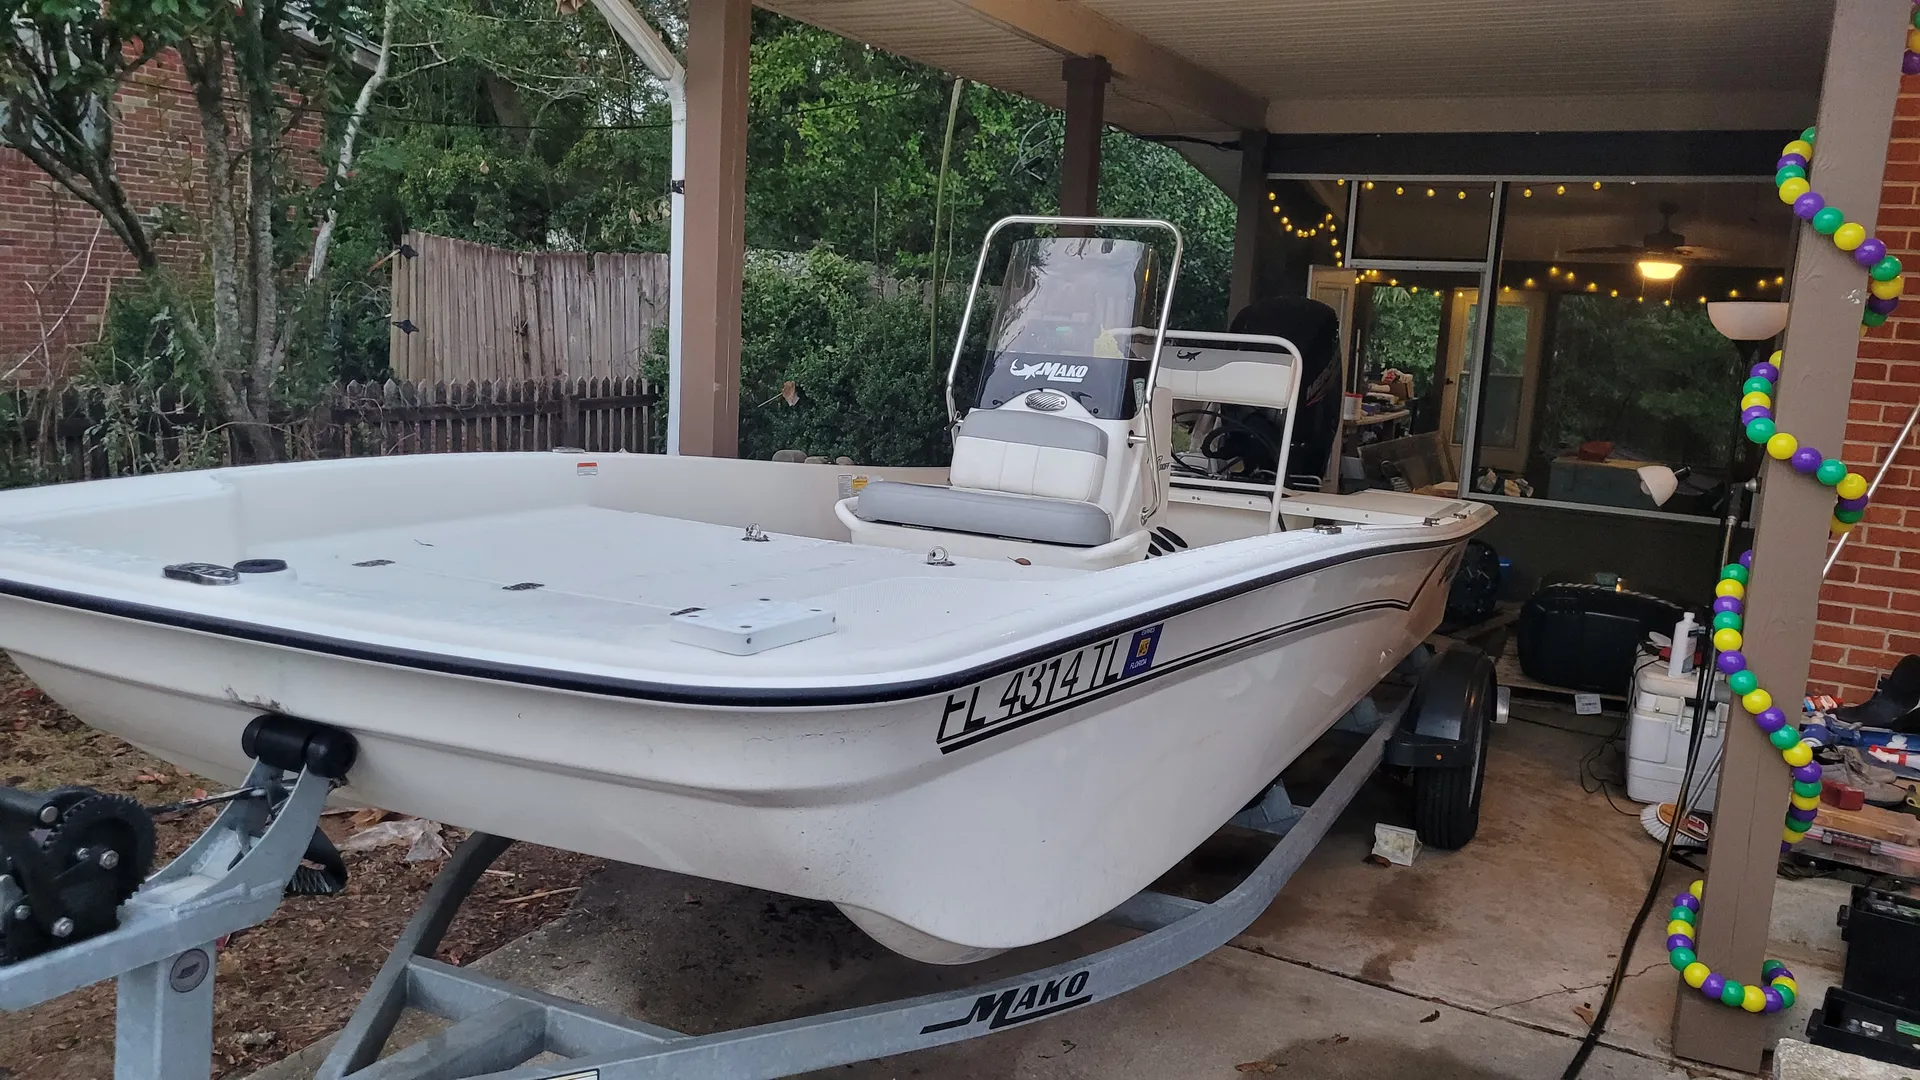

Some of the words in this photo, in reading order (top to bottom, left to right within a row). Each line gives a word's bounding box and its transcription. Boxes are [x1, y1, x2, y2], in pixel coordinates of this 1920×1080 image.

[1035, 362, 1089, 383] MAKO
[998, 650, 1084, 717] 4314
[1089, 638, 1119, 690] TL
[1129, 658, 1148, 670] FLORIDA
[920, 971, 1093, 1034] MAKO
